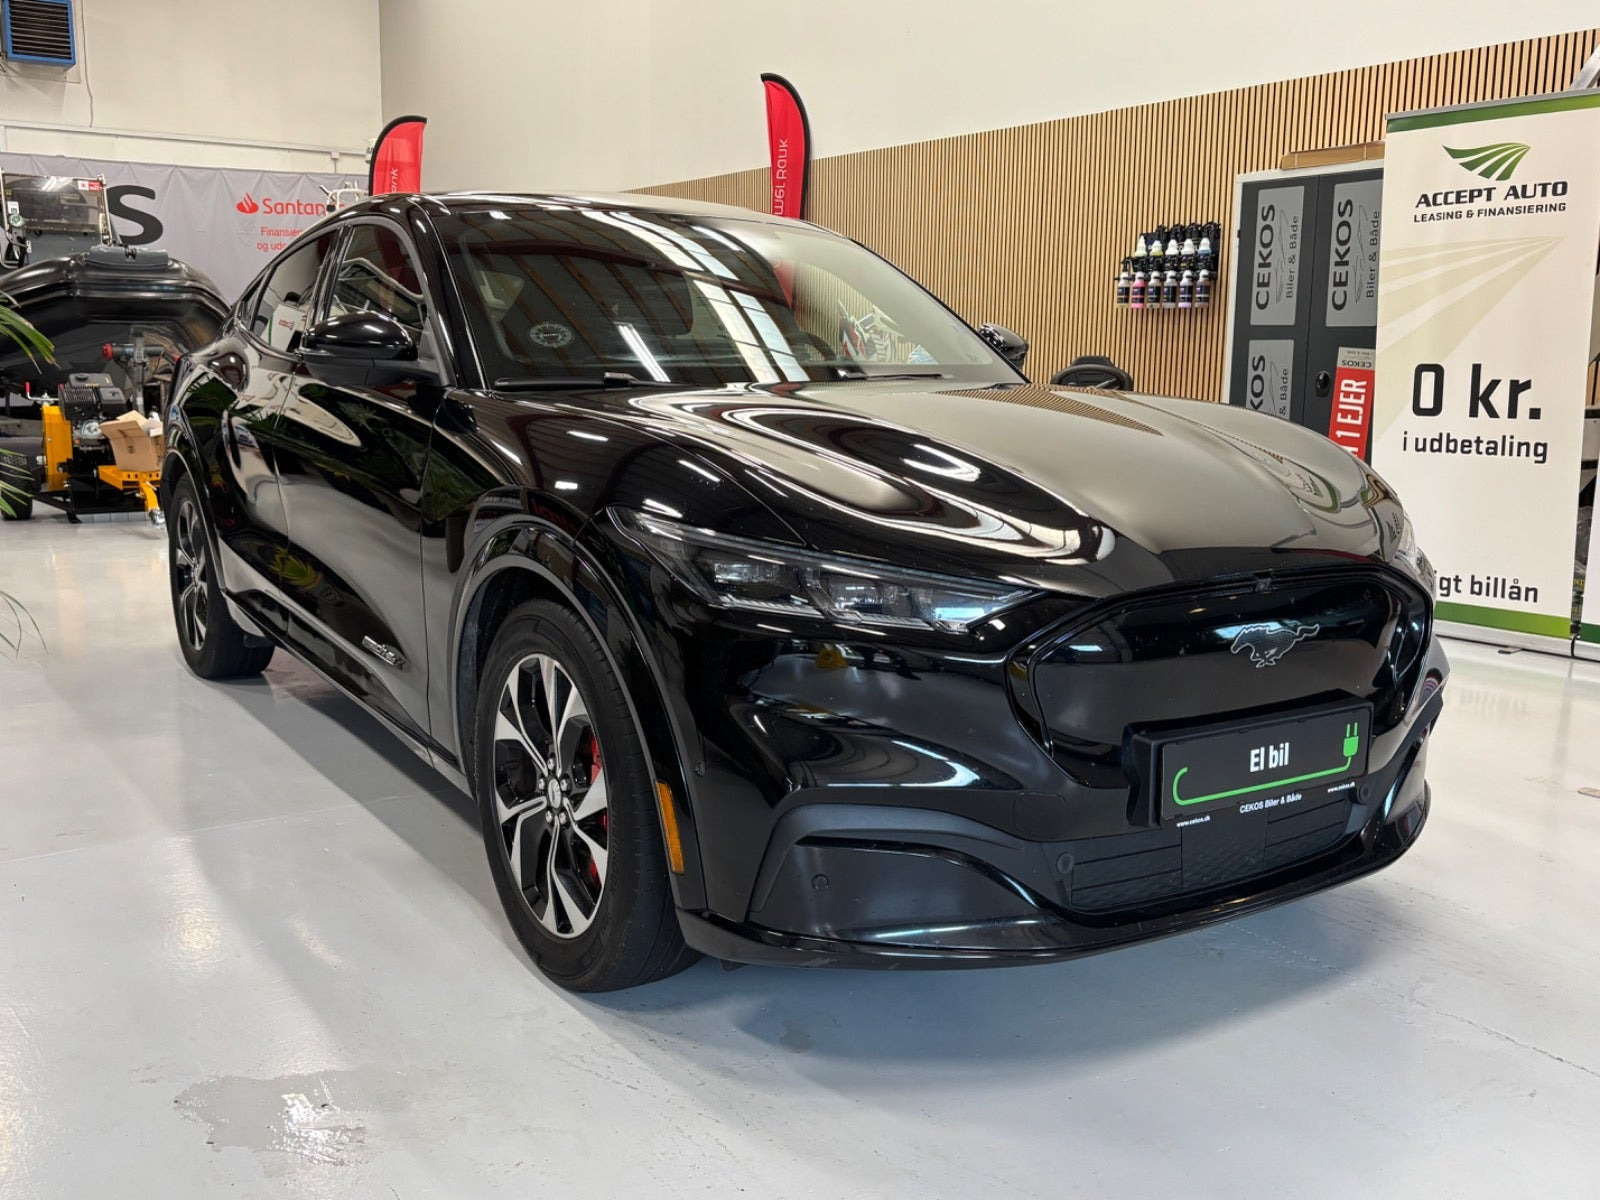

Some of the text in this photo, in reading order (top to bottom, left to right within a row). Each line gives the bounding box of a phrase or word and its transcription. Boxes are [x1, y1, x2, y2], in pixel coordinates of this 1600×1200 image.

[391, 168, 399, 193] ank
[1415, 181, 1568, 208] ACCEPT AUTO
[107, 184, 164, 246] S
[262, 197, 327, 216] Santan
[1414, 202, 1567, 223] LEASING & FINANSIERING
[257, 243, 268, 252] og
[1255, 204, 1276, 310] CEKOS
[1285, 216, 1299, 298] Biler & Både
[1332, 198, 1354, 311] CEKOS
[1366, 211, 1380, 298] Biler & Både
[1250, 355, 1266, 410] KOS
[1412, 363, 1542, 420] 0 kr.
[1336, 379, 1367, 426] EJER
[1335, 430, 1361, 438] 1
[1402, 431, 1548, 464] i udbetaling
[1434, 571, 1538, 603] gt billån
[1250, 742, 1290, 773] El bil
[1240, 801, 1264, 813] CEKOS
[1265, 798, 1280, 809] Biler
